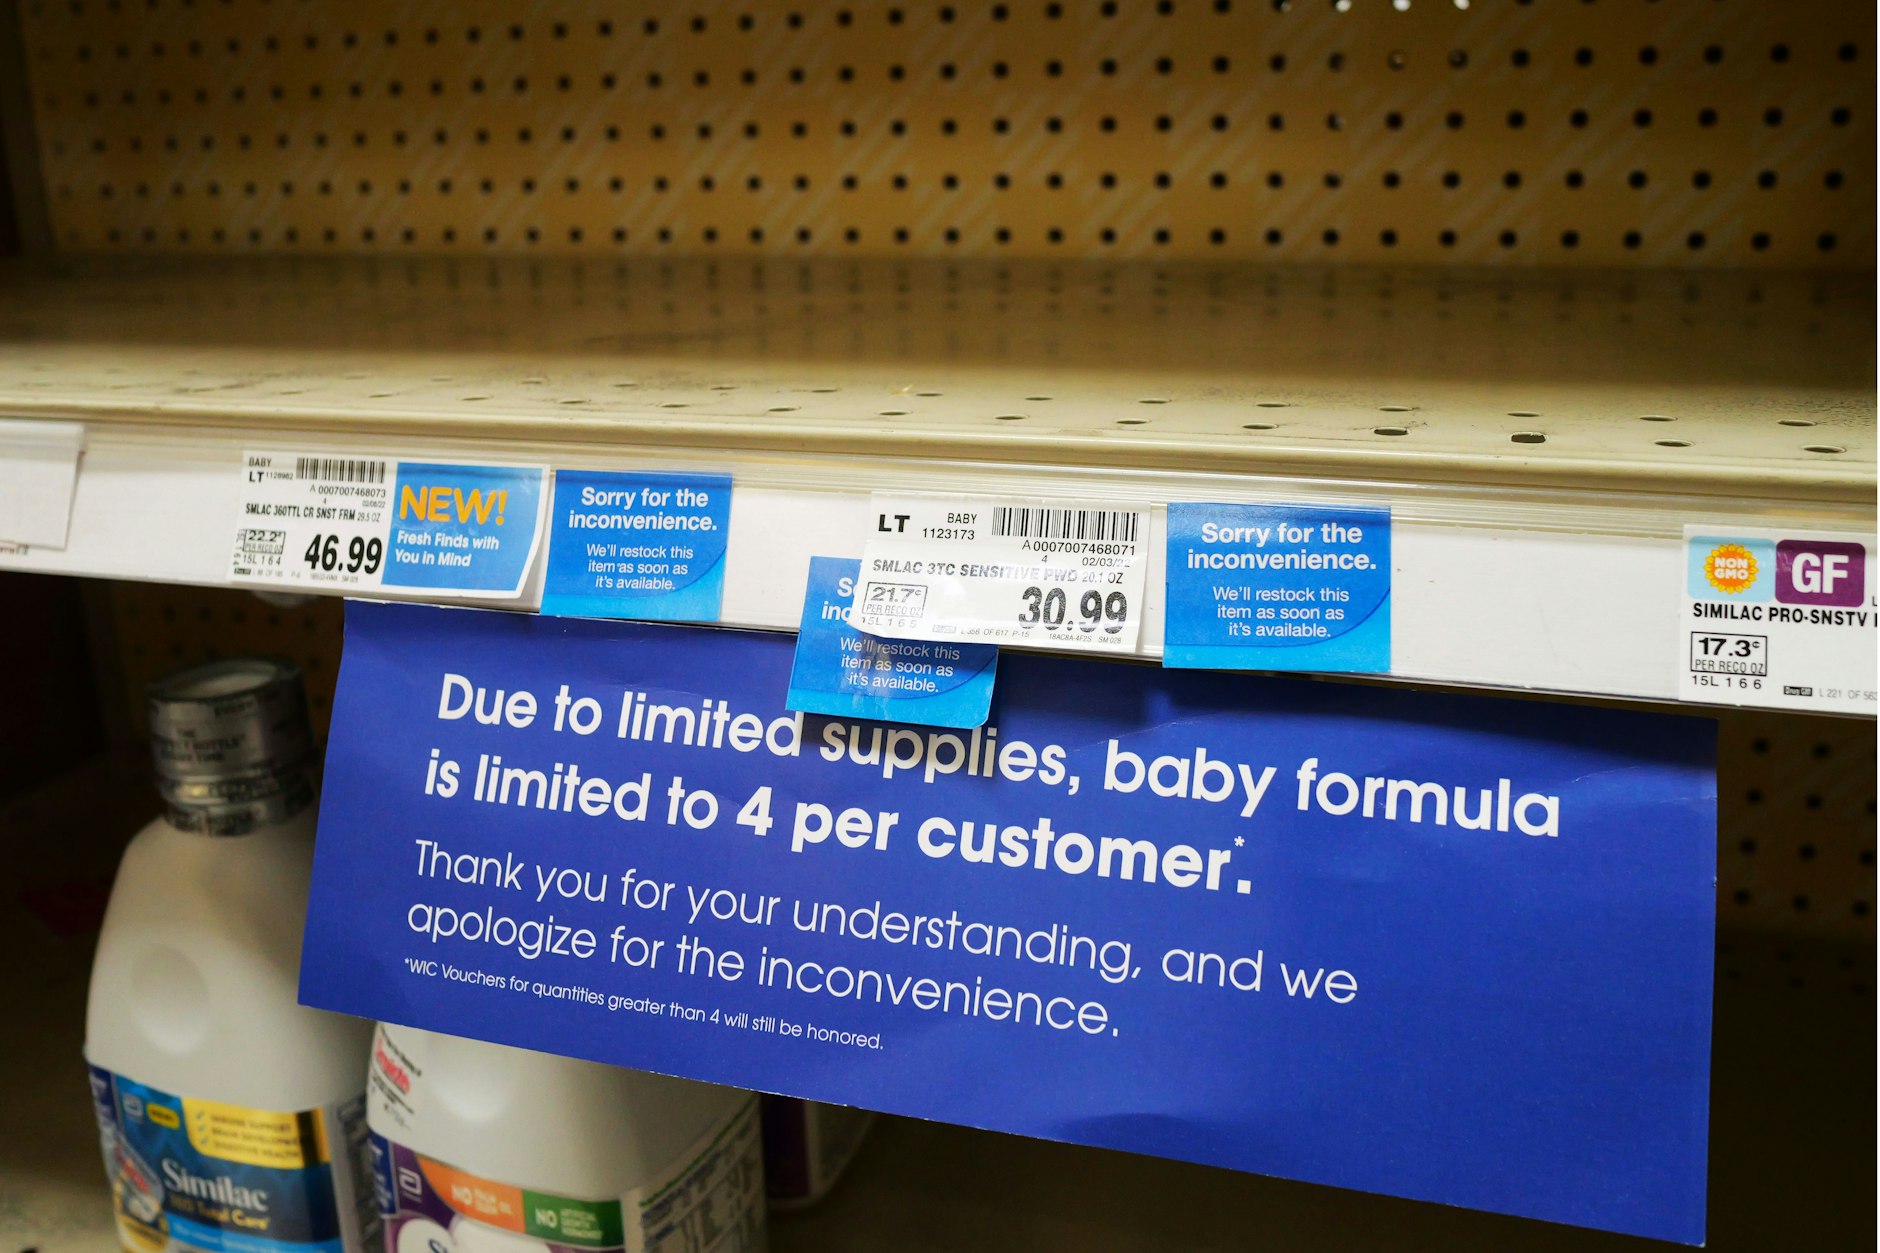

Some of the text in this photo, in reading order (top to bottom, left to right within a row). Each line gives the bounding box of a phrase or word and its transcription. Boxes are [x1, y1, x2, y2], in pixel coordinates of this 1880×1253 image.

[248, 456, 272, 467] BABY
[249, 471, 264, 483] LT
[318, 485, 386, 498] 0007007468073
[581, 486, 709, 510] Sorry for the
[245, 502, 271, 516] SMLAC
[273, 504, 301, 518] 360TTL
[303, 506, 315, 519] CR
[316, 507, 336, 520] SNST
[338, 508, 356, 521] FRM
[400, 484, 508, 526] NEW!
[568, 510, 718, 531] inconvenience.
[878, 512, 978, 533] LT BABY
[397, 530, 500, 550] Fresh Finds with
[922, 528, 976, 541] 1123173
[1201, 522, 1363, 548] Sorry for the
[304, 533, 383, 575] 46.99
[395, 548, 472, 567] You in Mind
[586, 543, 694, 559] We'll restock this
[1041, 554, 1048, 564] 4
[1187, 549, 1377, 570] inconvenience.
[588, 560, 689, 575] item as soon as
[872, 559, 1124, 585] SMLAC 3TC SENSITIVE PWD 20.1 OZ
[1714, 557, 1749, 569] NON
[595, 576, 676, 591] it's available.
[1714, 568, 1749, 581] GMO
[1791, 552, 1850, 595] GF
[1213, 586, 1350, 602] We'll restock this
[866, 603, 922, 616] PER RECO OZ
[1018, 586, 1129, 635] 30.99
[1217, 604, 1344, 620] item as soon as
[1693, 603, 1763, 621] SIMILAC
[1768, 607, 1868, 628] PRO-SNSTV
[887, 617, 893, 627] 1
[898, 618, 906, 628] 6
[1229, 622, 1331, 638] it's available.
[983, 628, 995, 636] OF
[995, 629, 1009, 637] 617
[1012, 630, 1030, 638] P-15
[840, 636, 961, 661] We'll restock this
[840, 654, 954, 677] item as soon as
[1695, 659, 1764, 675] PER RECO OZ
[848, 671, 939, 693] it's available.
[1692, 675, 1762, 690] 15L 1 6 6
[1819, 688, 1825, 698] L
[1826, 688, 1842, 698] 221
[1847, 690, 1861, 700] OF
[438, 672, 1560, 838] Due to limited supplies, baby formula
[425, 749, 461, 799] is
[473, 754, 652, 822] limited
[666, 775, 720, 830] to
[736, 785, 775, 837] 4
[791, 801, 901, 854] per
[414, 839, 1359, 1004] Thank you for your understanding, and we
[405, 903, 1120, 1038] apologize for the inconvenience.
[441, 963, 506, 991] Vouchers
[508, 974, 530, 993] for
[531, 979, 605, 1008] quantities
[607, 993, 666, 1018] greater
[669, 1001, 707, 1024] than
[709, 1008, 721, 1025] 4
[723, 1010, 749, 1030] will
[751, 1015, 777, 1034] still
[779, 1019, 803, 1038] be
[806, 1021, 884, 1051] honored.
[161, 1157, 269, 1213] Similac
[451, 1184, 474, 1207] NO
[535, 1208, 559, 1229] NO
